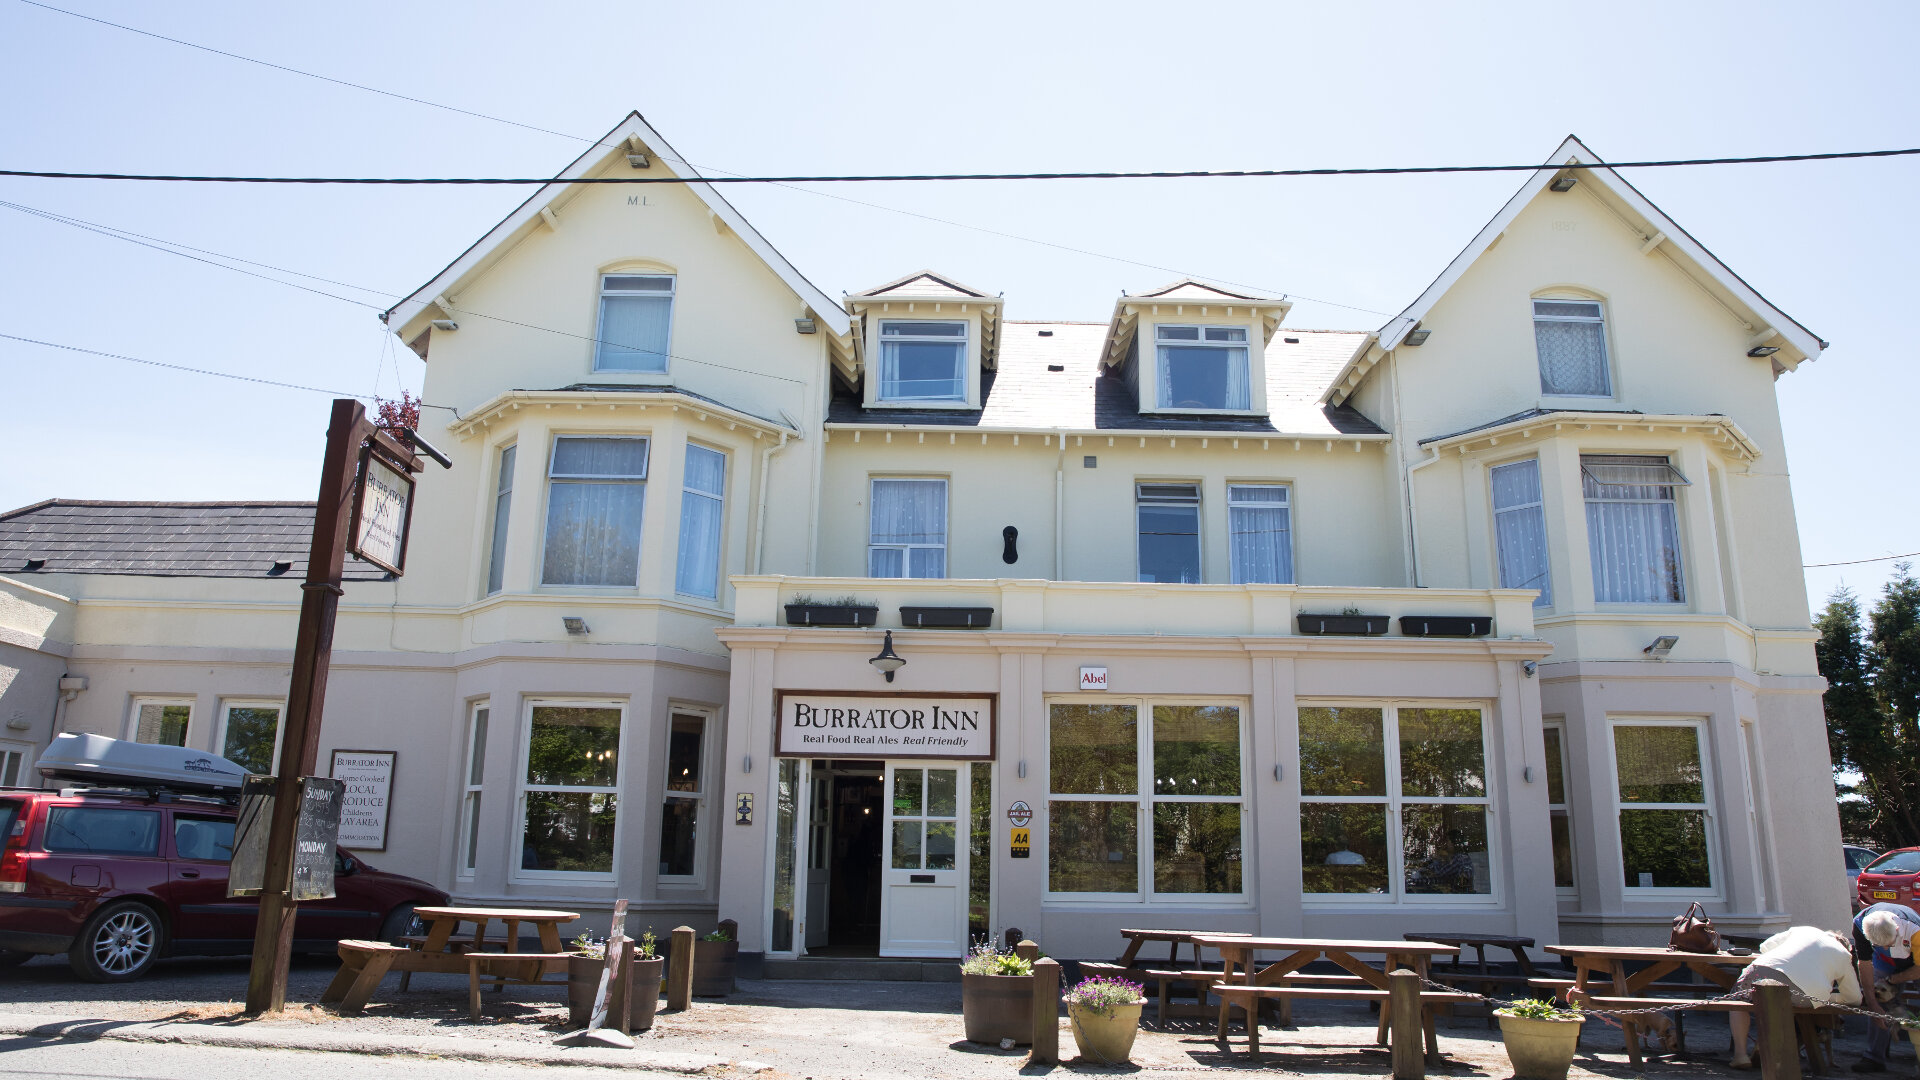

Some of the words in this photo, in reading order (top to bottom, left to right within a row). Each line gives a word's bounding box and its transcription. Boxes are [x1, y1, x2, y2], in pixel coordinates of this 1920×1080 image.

[366, 472, 406, 509] BURRATOR
[1082, 672, 1106, 684] Abel
[794, 703, 925, 730] BURRATOR
[932, 705, 979, 731] INN
[803, 734, 825, 744] Real
[827, 734, 851, 744] Food
[853, 735, 875, 745] Real
[877, 735, 899, 745] Ales
[902, 736, 926, 746] Real
[927, 736, 969, 748] Friendly
[336, 757, 375, 767] BURRATOR
[376, 758, 390, 767] INN
[360, 775, 385, 783] Cooked
[306, 786, 334, 803] SUNDAY
[344, 784, 377, 795] LOCAL
[342, 796, 384, 807] RODUCE
[342, 809, 373, 817] Childrens
[1014, 833, 1028, 844] AA
[299, 841, 326, 856] MONDAY
